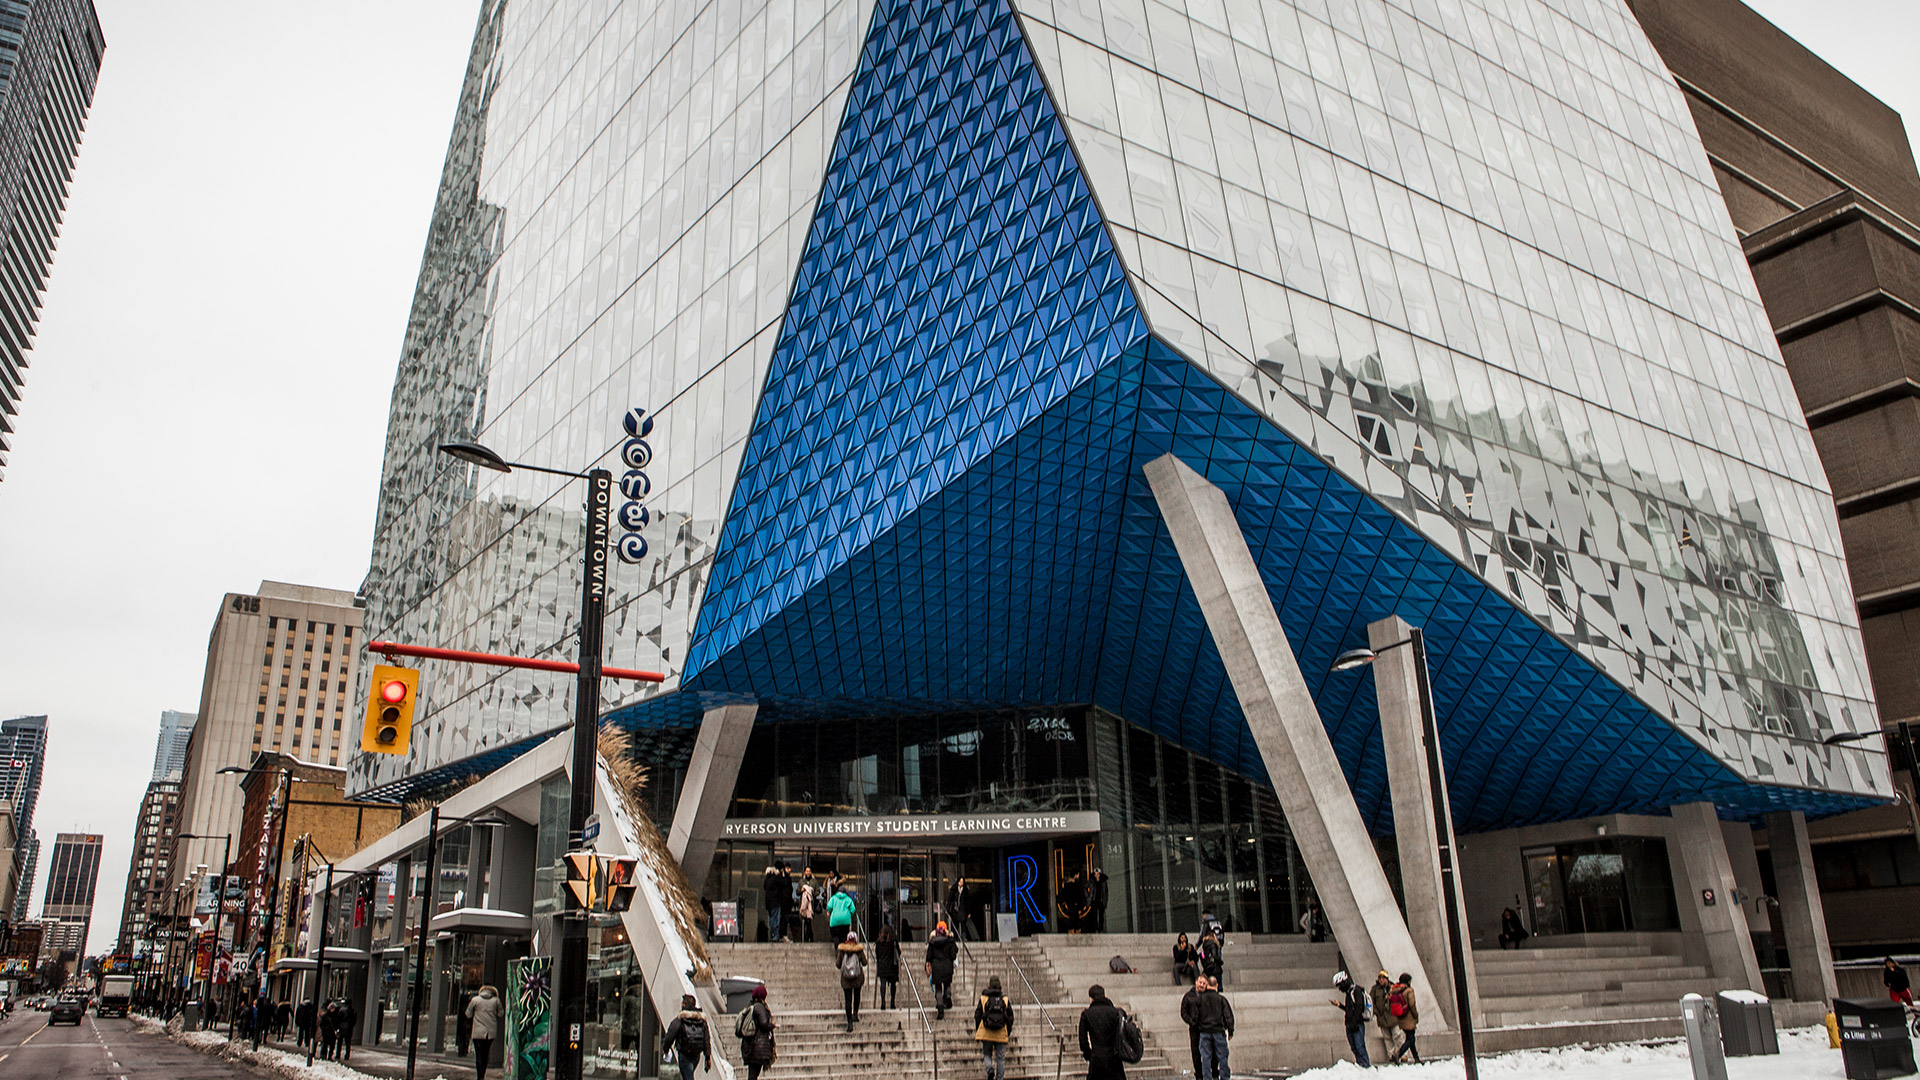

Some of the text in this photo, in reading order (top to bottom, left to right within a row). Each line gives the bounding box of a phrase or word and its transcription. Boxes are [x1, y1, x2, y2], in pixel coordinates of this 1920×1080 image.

[619, 408, 653, 563] Yonge
[591, 478, 608, 595] DOWNTOWN
[232, 596, 261, 612] 415
[726, 817, 1067, 834] RYERSON UNIVERSITY STUDENT LEARNING CENTRE
[250, 818, 270, 927] ZANZIBAR
[233, 961, 248, 971] 40
